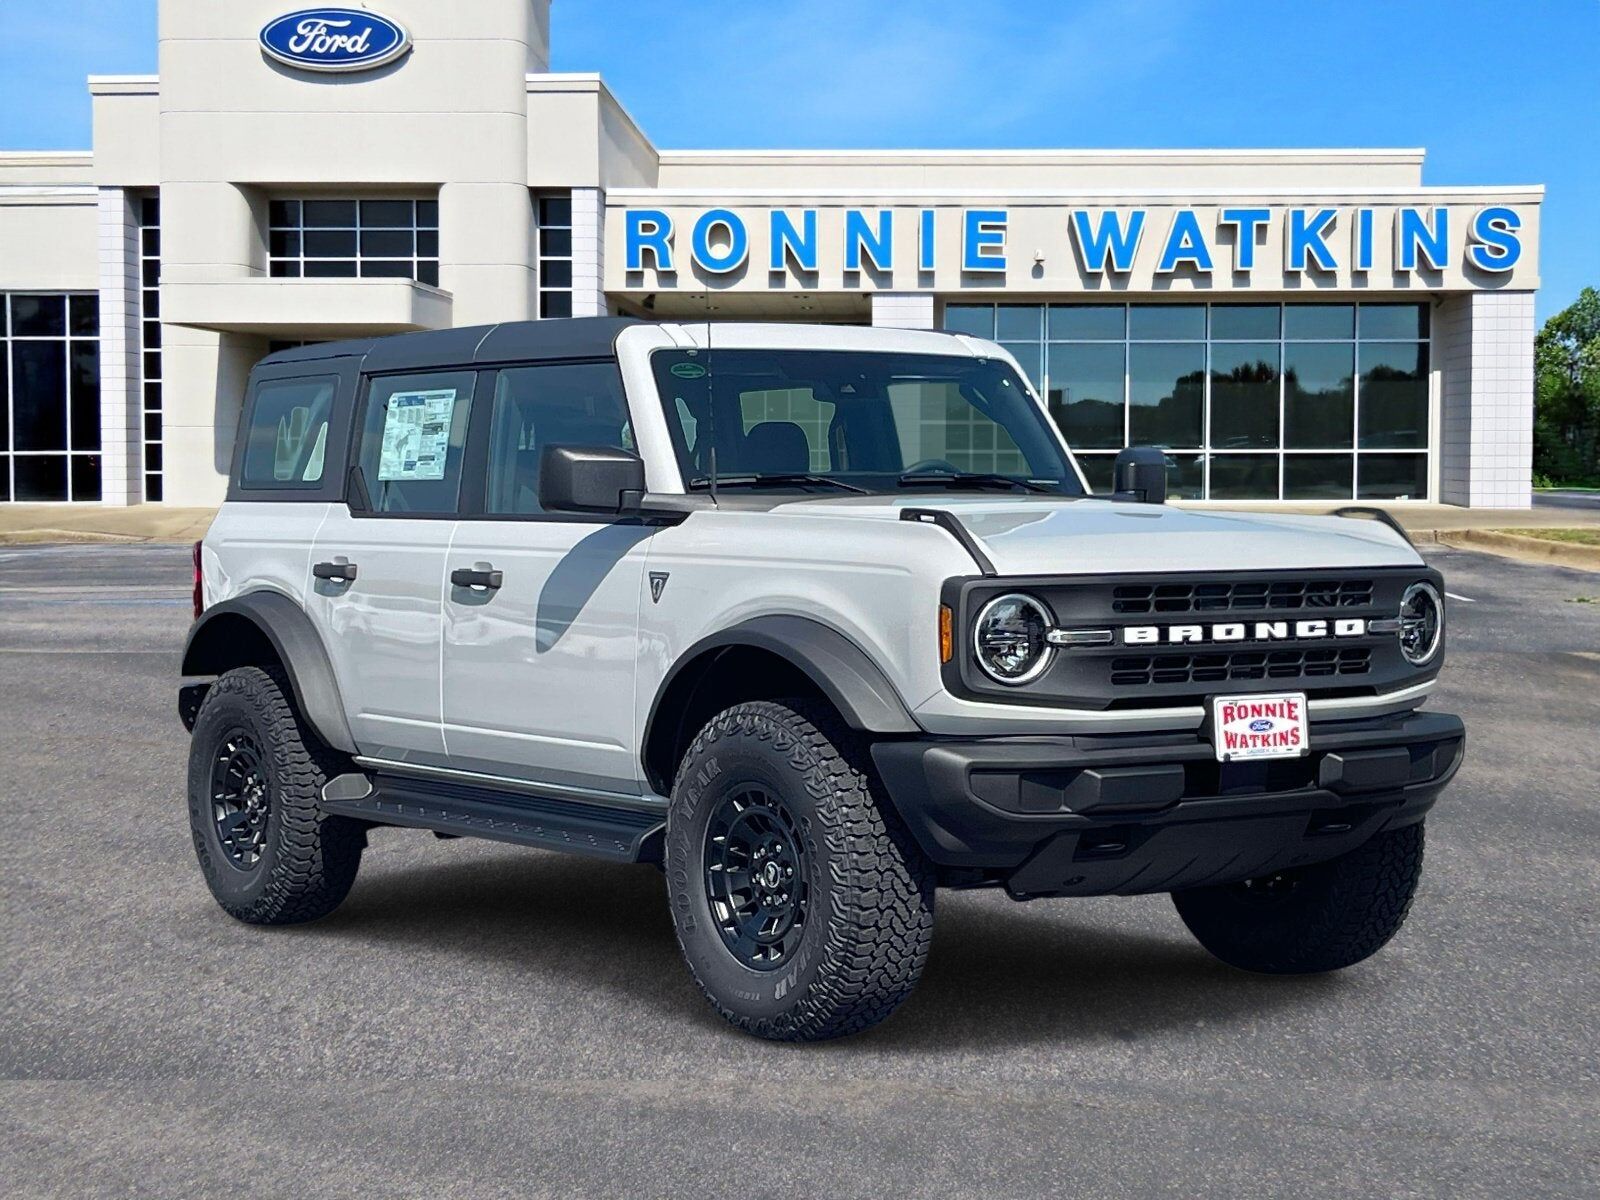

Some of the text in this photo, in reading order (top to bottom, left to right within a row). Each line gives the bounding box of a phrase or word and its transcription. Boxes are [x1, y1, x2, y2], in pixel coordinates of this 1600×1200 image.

[289, 18, 372, 54] Ford
[624, 206, 1523, 274] RONNIE WATKINS
[1123, 619, 1366, 644] BRONCO
[1222, 702, 1299, 725] RONNIE
[1251, 720, 1272, 731] Ford
[1223, 726, 1301, 749] WATKINS
